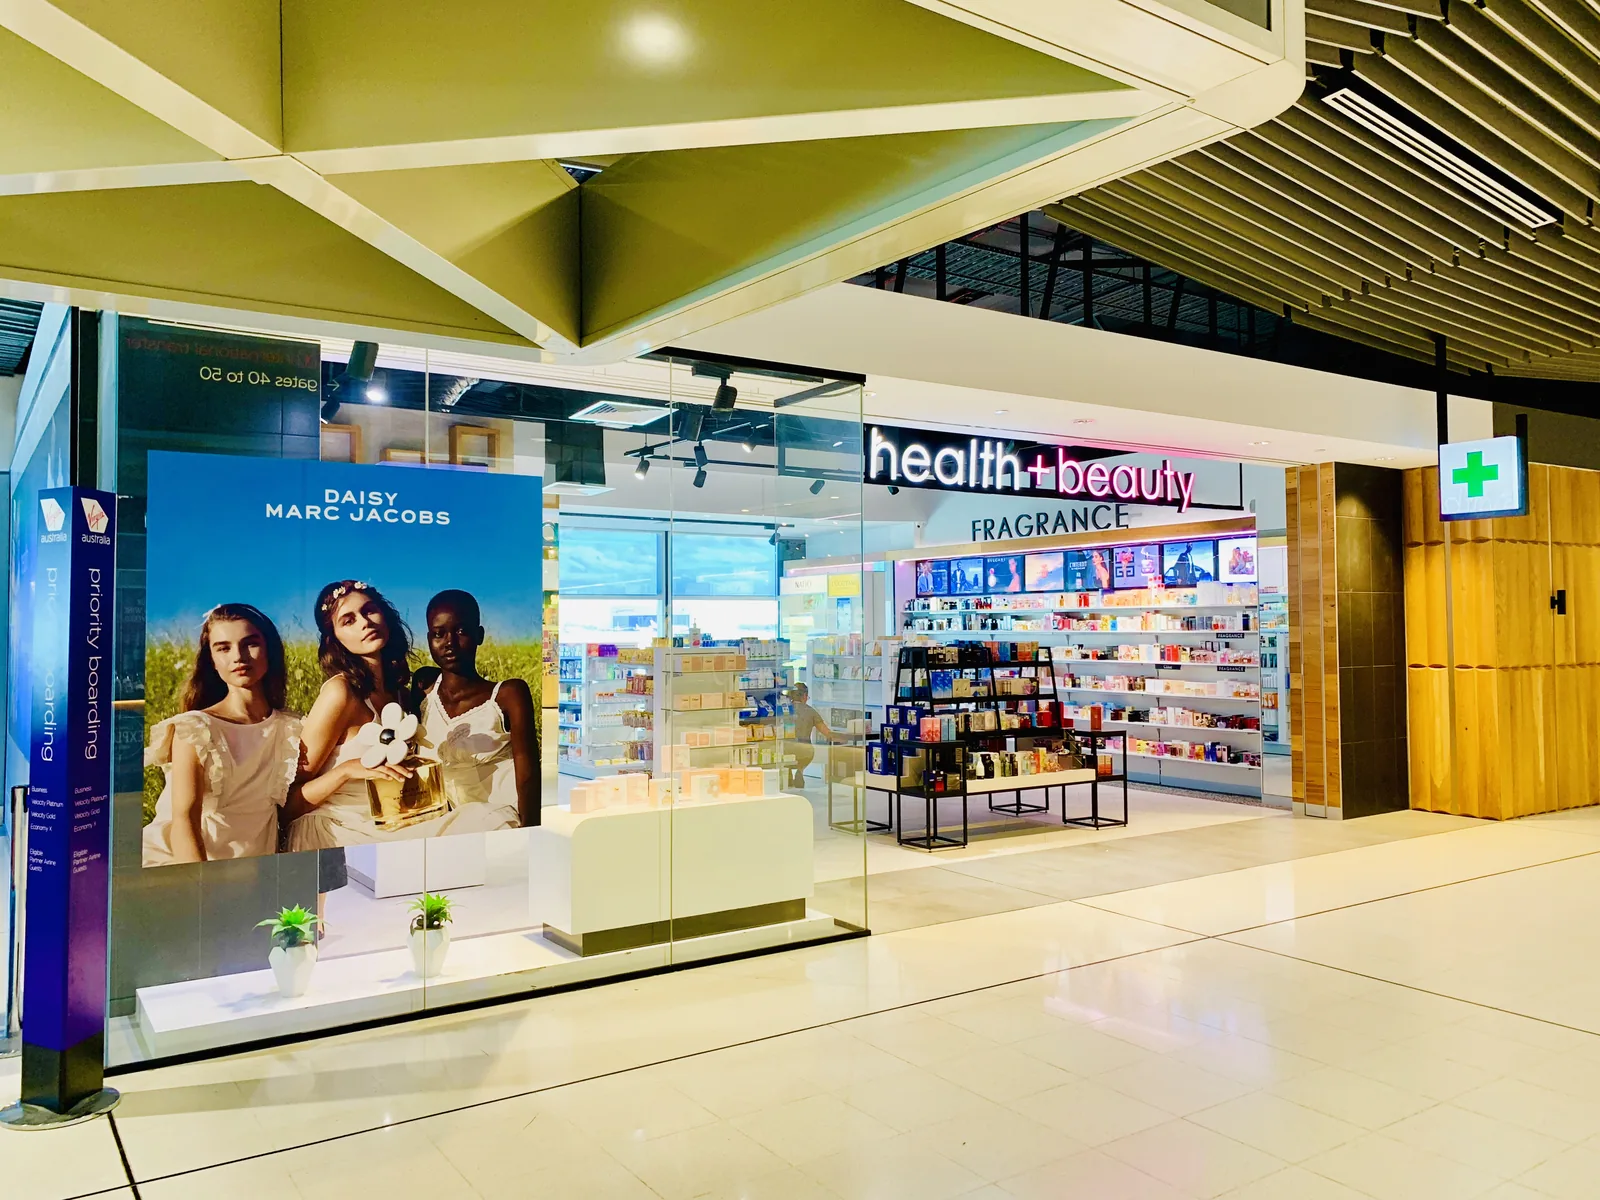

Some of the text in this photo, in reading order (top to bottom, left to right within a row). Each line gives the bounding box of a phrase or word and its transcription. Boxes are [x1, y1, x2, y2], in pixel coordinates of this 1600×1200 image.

[324, 488, 398, 506] DAISY
[266, 504, 450, 525] MARC JACOBS
[971, 503, 1130, 542] FRAGRANCE
[40, 532, 67, 544] australia
[82, 533, 110, 545] australia
[85, 568, 103, 760] priority boarding
[41, 667, 56, 762] oarding
[74, 786, 92, 794] Business
[30, 823, 48, 832] Economy
[74, 824, 92, 832] Economy
